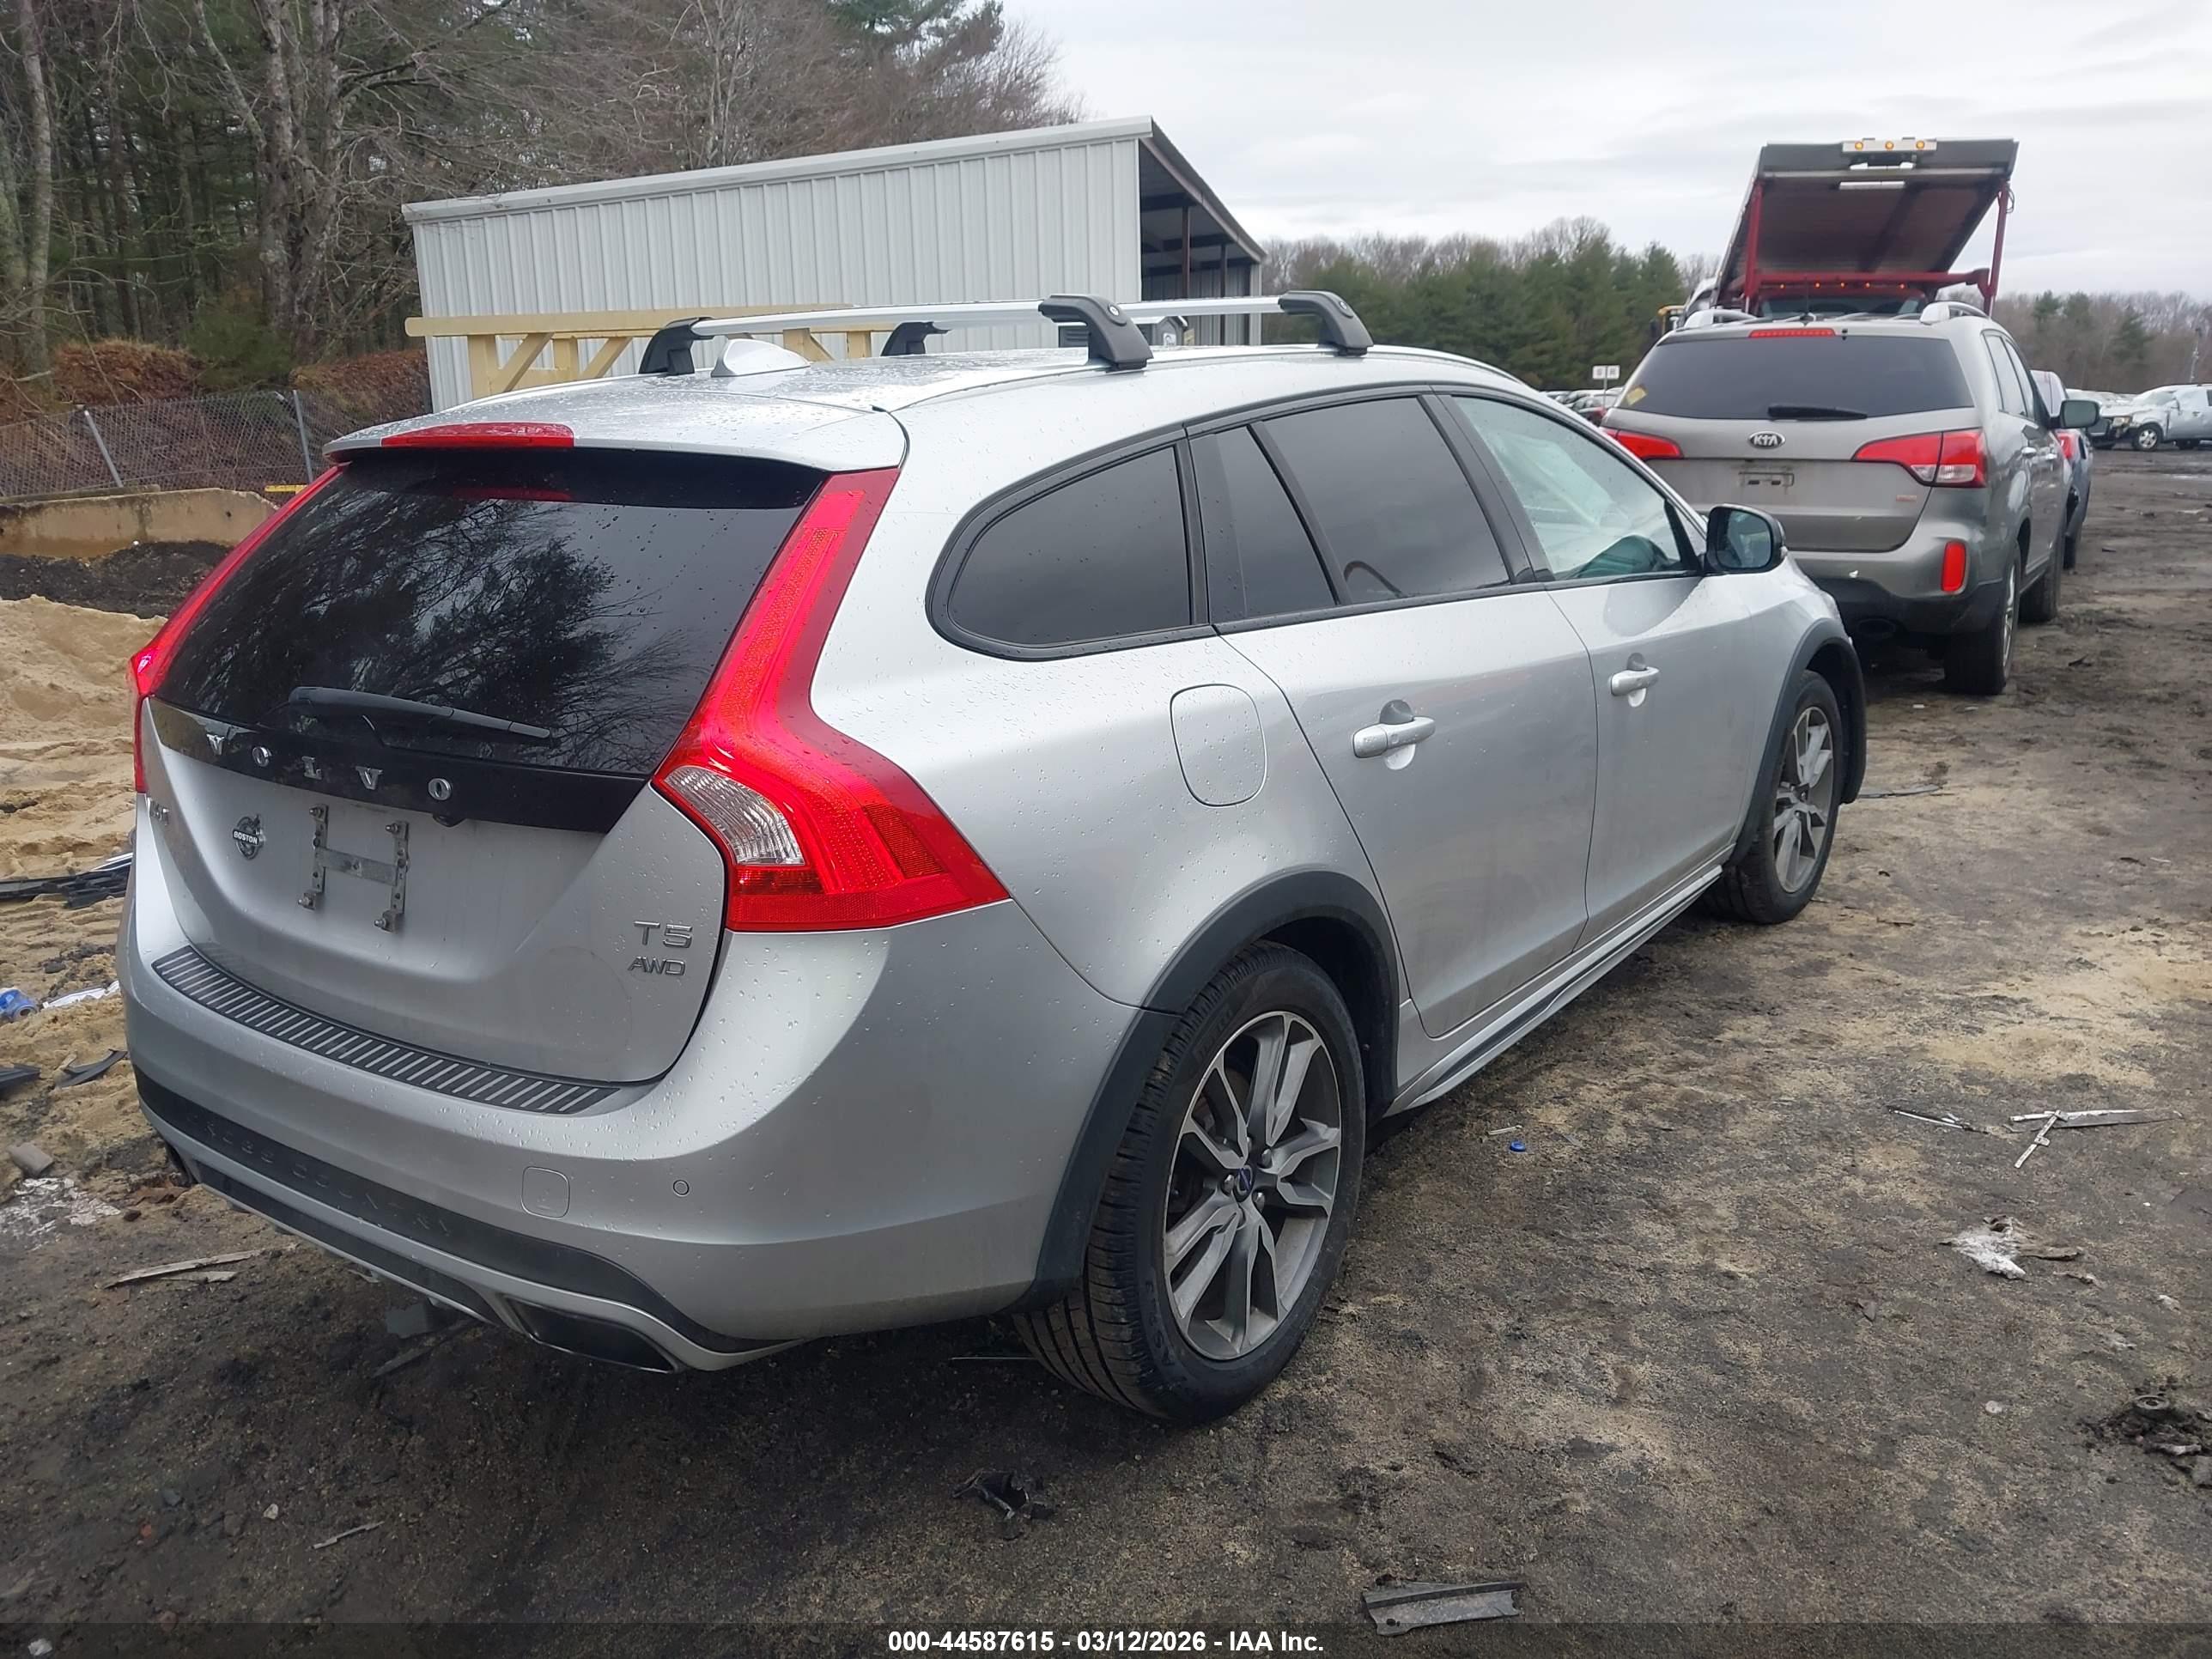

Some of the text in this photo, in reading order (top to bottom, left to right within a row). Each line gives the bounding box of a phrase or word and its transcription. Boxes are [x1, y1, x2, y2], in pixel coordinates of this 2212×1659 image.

[206, 733, 453, 801] VOLVO
[234, 830, 258, 845] BOSTON
[634, 921, 693, 948] T5
[628, 957, 685, 975] AWD
